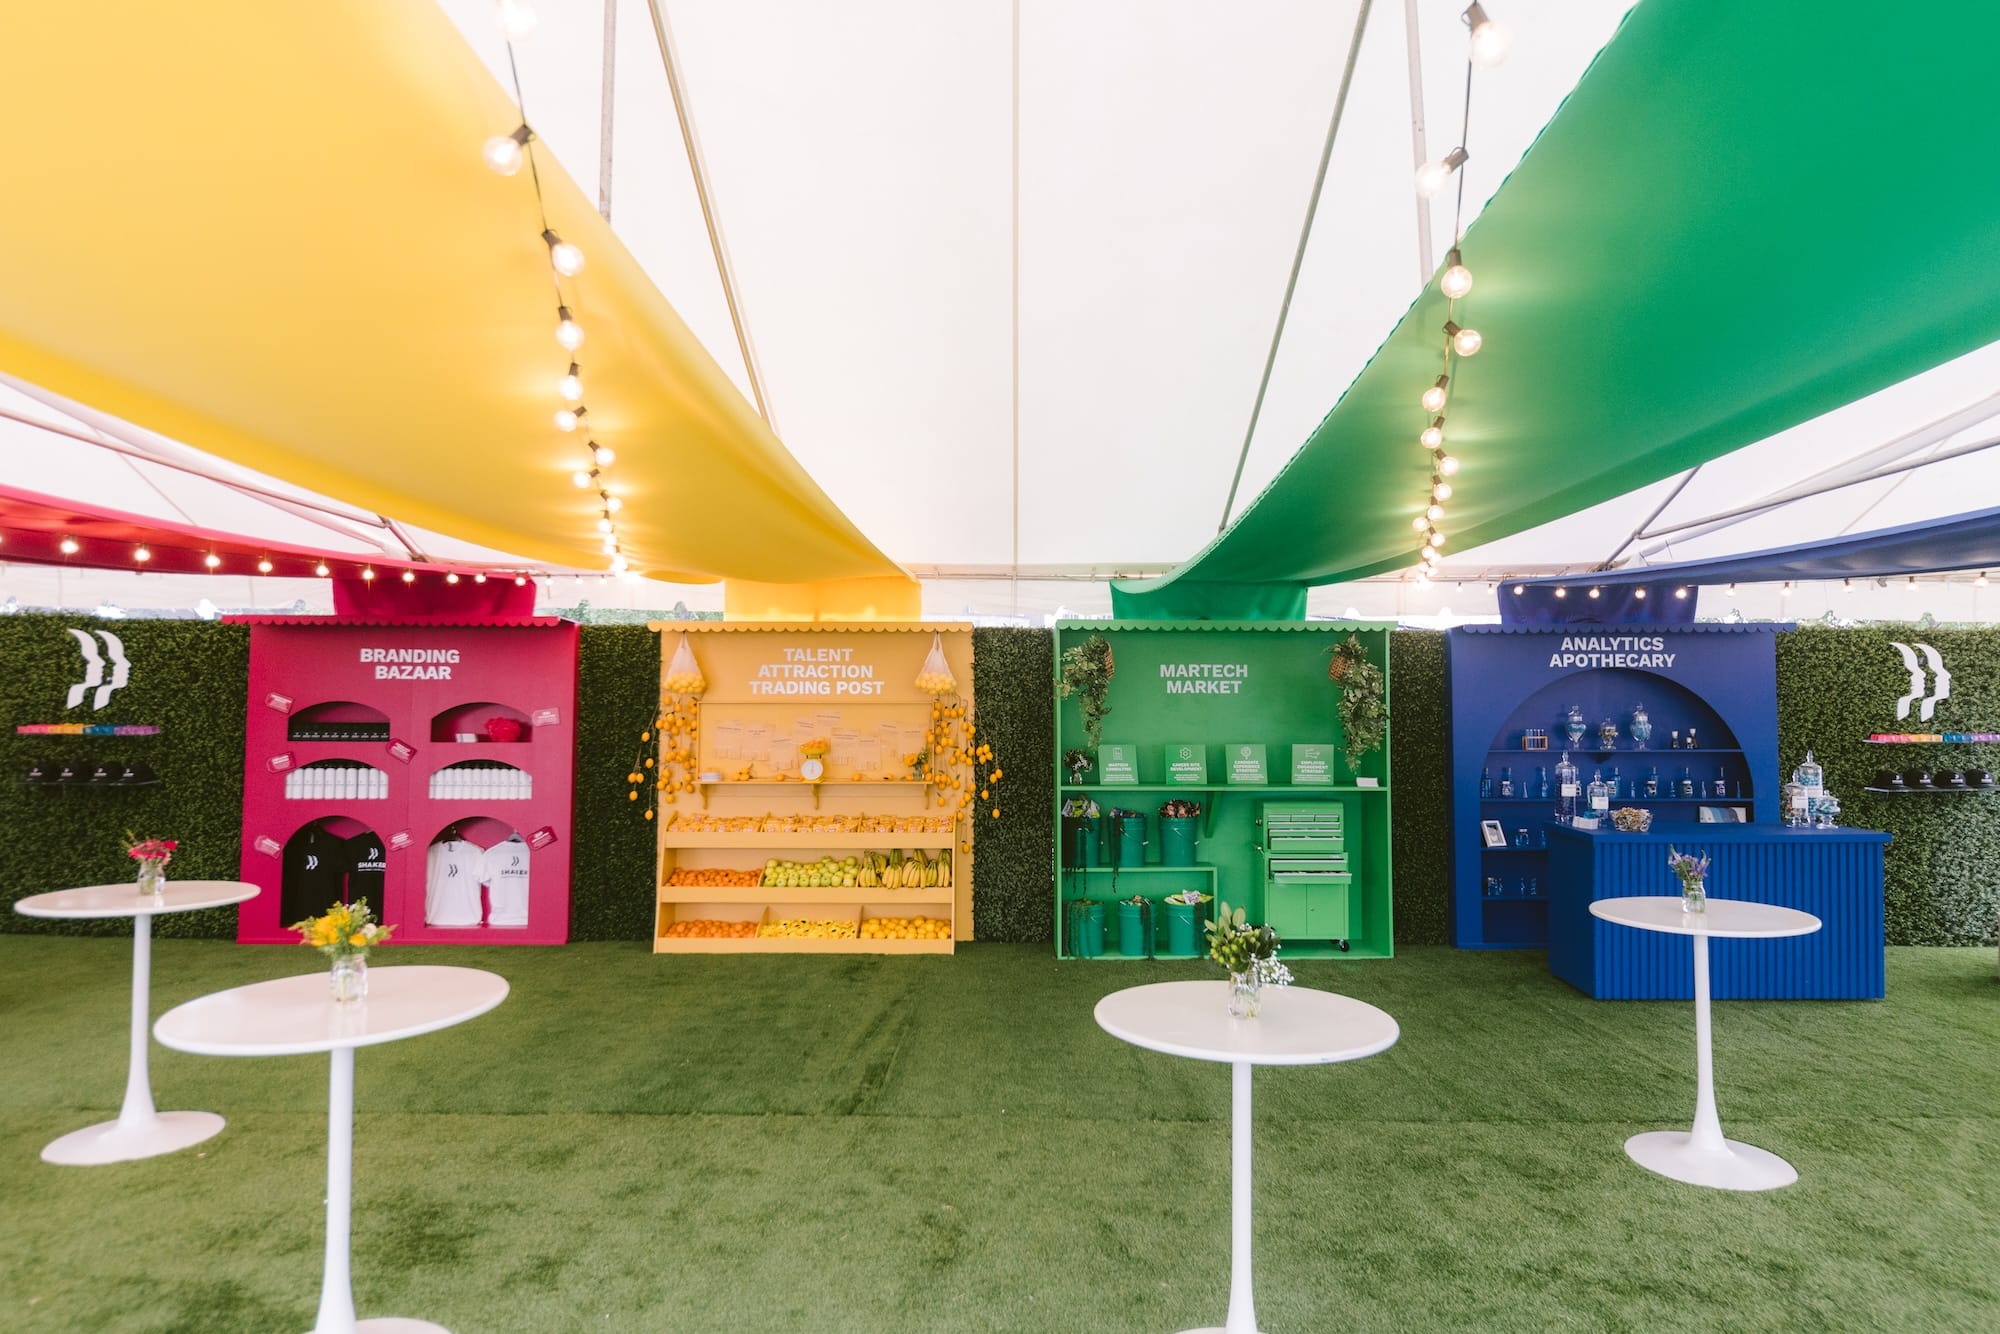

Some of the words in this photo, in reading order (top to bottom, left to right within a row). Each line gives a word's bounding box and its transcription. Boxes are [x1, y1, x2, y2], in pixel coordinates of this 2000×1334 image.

[1560, 637, 1665, 651] ANALYTICS
[360, 648, 461, 663] BRANDING
[783, 648, 854, 662] TALENT
[1549, 653, 1677, 668] APOTHECARY
[375, 665, 452, 680] BAZAAR
[758, 664, 874, 678] ATTRACTION
[1160, 664, 1249, 678] MARTECH
[749, 681, 832, 695] TRADING
[836, 681, 885, 695] POST
[1166, 680, 1243, 694] MARKET
